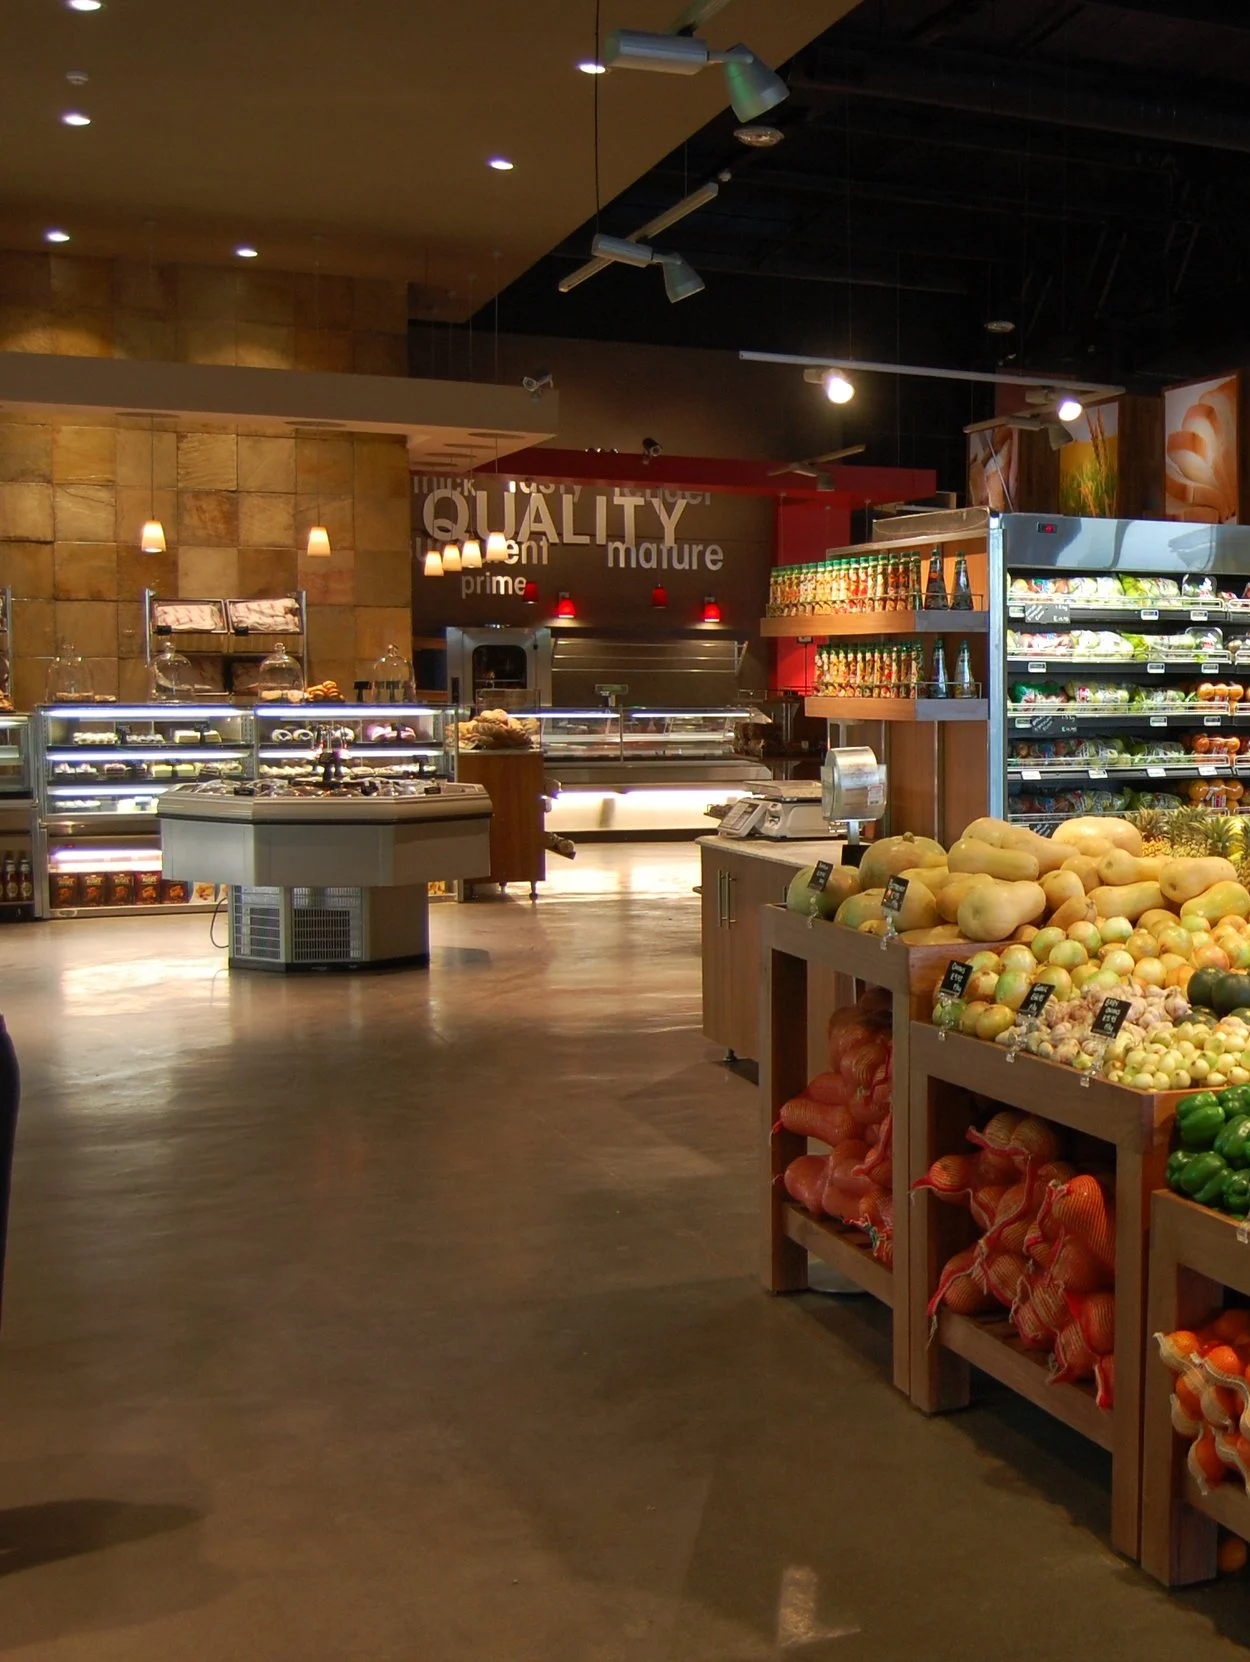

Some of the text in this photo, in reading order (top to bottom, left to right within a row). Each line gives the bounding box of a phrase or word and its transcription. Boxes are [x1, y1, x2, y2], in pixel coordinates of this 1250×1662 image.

[423, 488, 689, 547] QUALITY
[608, 540, 724, 570] mature
[462, 572, 527, 599] prime
